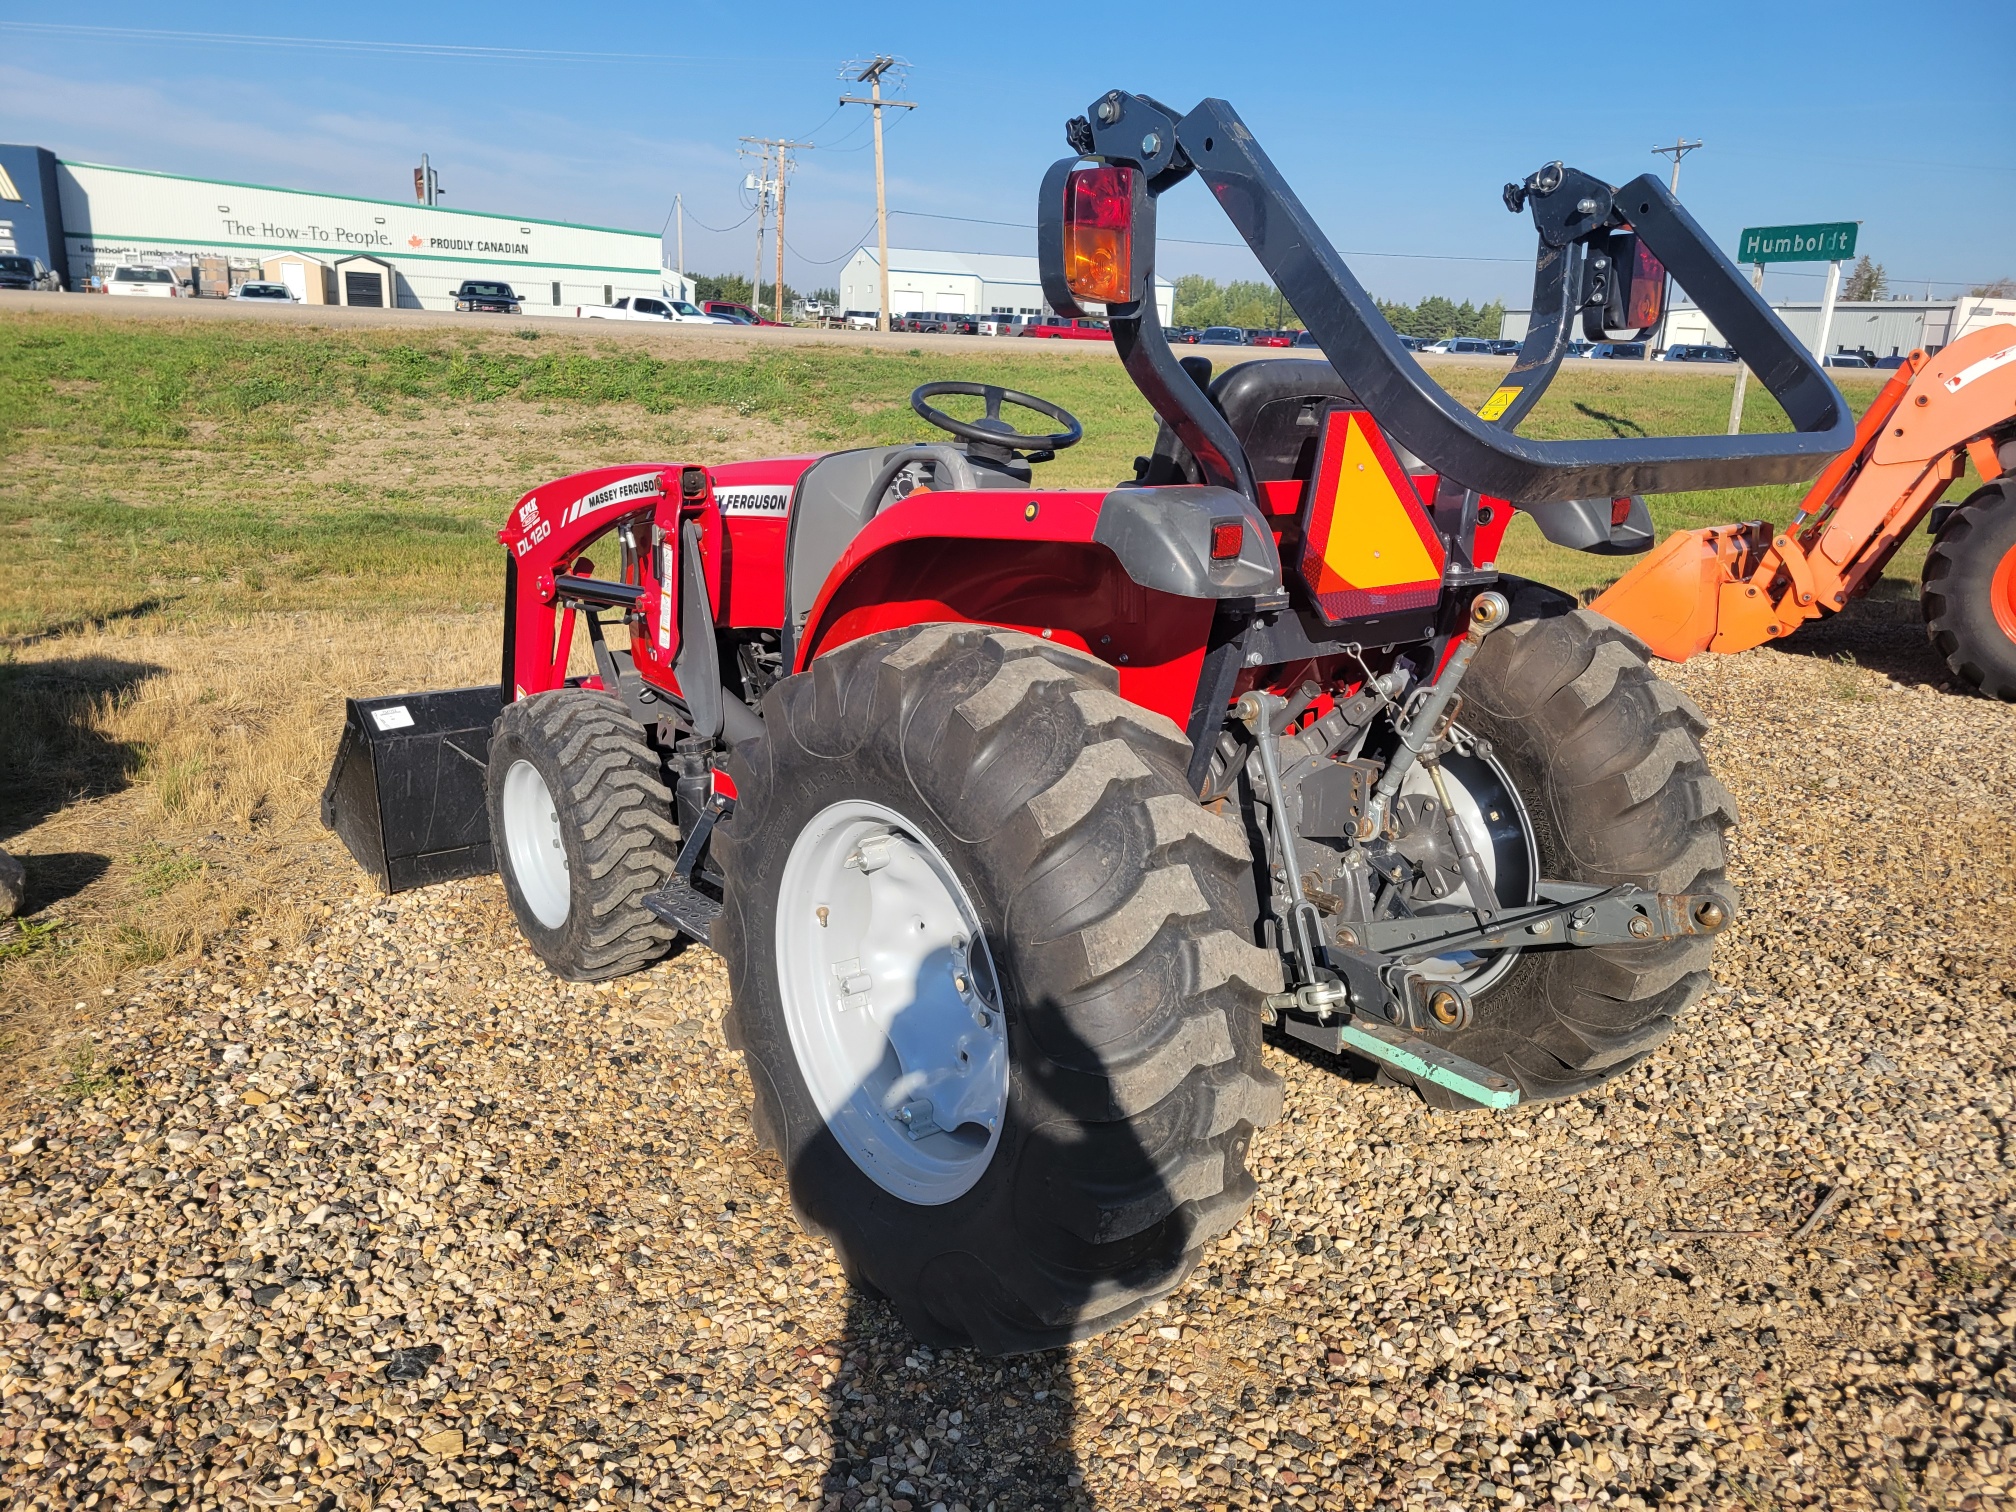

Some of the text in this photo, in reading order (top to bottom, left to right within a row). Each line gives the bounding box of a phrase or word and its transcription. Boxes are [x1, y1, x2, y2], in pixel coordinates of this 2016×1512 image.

[223, 220, 393, 247] The How-To People.
[1746, 232, 1848, 254] Humboldt
[430, 238, 529, 254] PROUDLY CANADIAN
[588, 488, 618, 508] MASSEY
[726, 494, 788, 510] FERGUSON
[530, 520, 551, 545] 120
